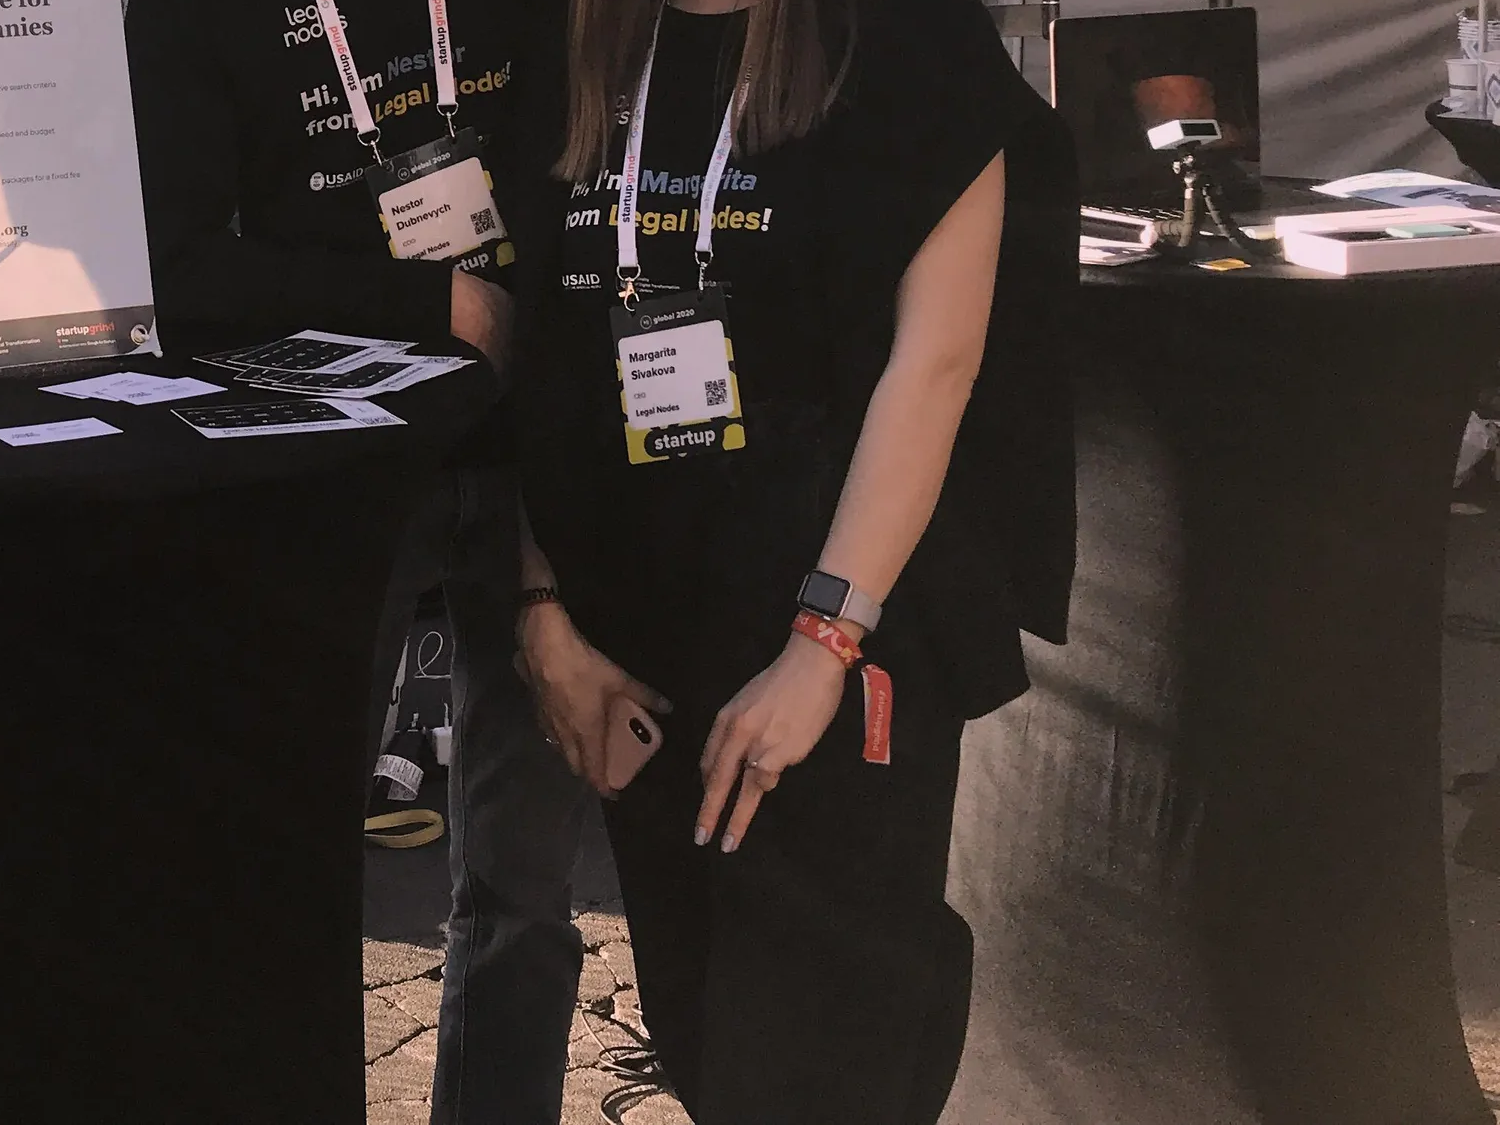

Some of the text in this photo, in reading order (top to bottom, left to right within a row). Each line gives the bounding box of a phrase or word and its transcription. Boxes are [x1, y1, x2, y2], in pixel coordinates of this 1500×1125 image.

[329, 26, 357, 91] startupgrind
[33, 81, 57, 89] criteria
[374, 82, 431, 124] Legal
[454, 60, 512, 96] odes!
[300, 84, 339, 112] Hi,
[15, 129, 29, 137] and
[30, 128, 55, 137] budget
[411, 152, 451, 173] global 2020
[326, 167, 364, 185] USAID
[622, 155, 636, 223] startupgrind
[391, 197, 424, 215] Nestor
[396, 203, 451, 231] Dubnevych
[428, 241, 450, 253] Nodes
[562, 274, 600, 287] USAID
[653, 308, 695, 325] global 2020
[56, 322, 115, 337] startupgrind
[629, 347, 677, 363] Margarita
[631, 365, 676, 380] Sivakova
[636, 404, 680, 417] Legal Nodes
[654, 430, 716, 450] startup
